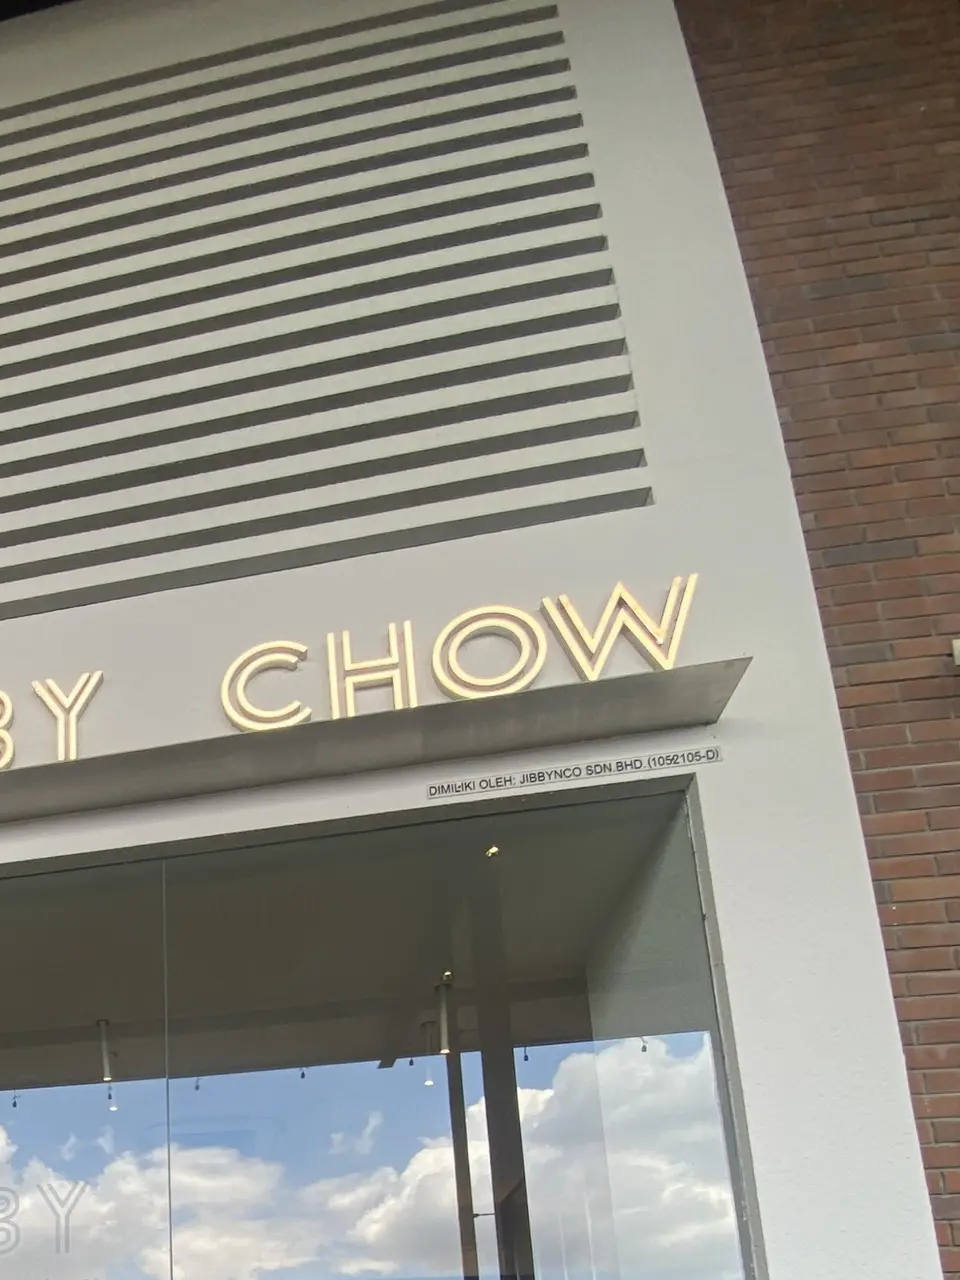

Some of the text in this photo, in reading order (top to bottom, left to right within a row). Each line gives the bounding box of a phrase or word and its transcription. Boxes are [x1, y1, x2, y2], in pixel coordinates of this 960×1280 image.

[221, 573, 700, 732] CHOW
[429, 781, 476, 796] DIMILIKI
[478, 775, 516, 790] OLEH:
[520, 766, 582, 785] JIBBYNCO
